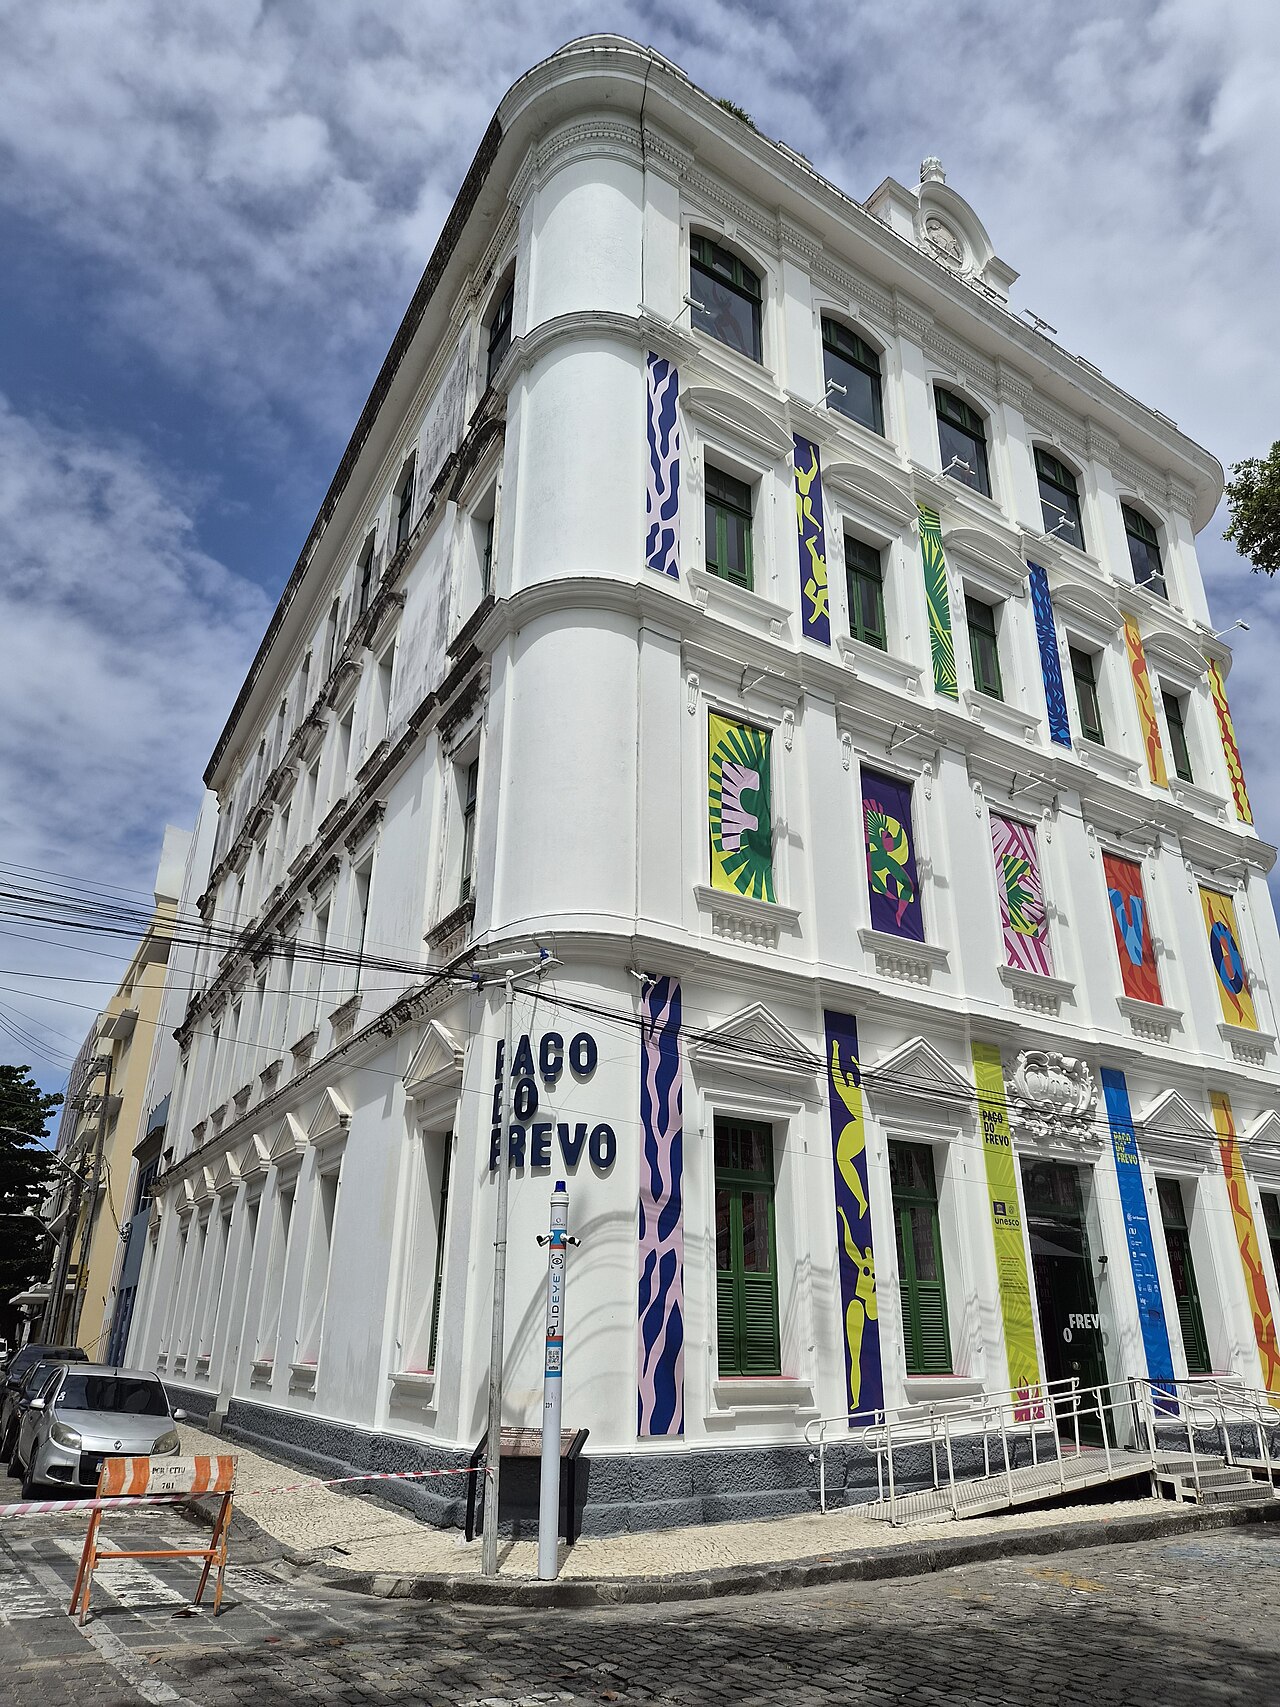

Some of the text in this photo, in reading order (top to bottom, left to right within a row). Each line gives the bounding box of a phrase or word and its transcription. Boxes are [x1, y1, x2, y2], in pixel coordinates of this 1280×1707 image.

[982, 1110, 1003, 1125] PAÇO
[984, 1121, 995, 1134] DO
[985, 1132, 1010, 1147] FREVO
[1114, 1141, 1125, 1153] DO
[1116, 1152, 1138, 1166] FREVO
[994, 1217, 1020, 1227] unesco
